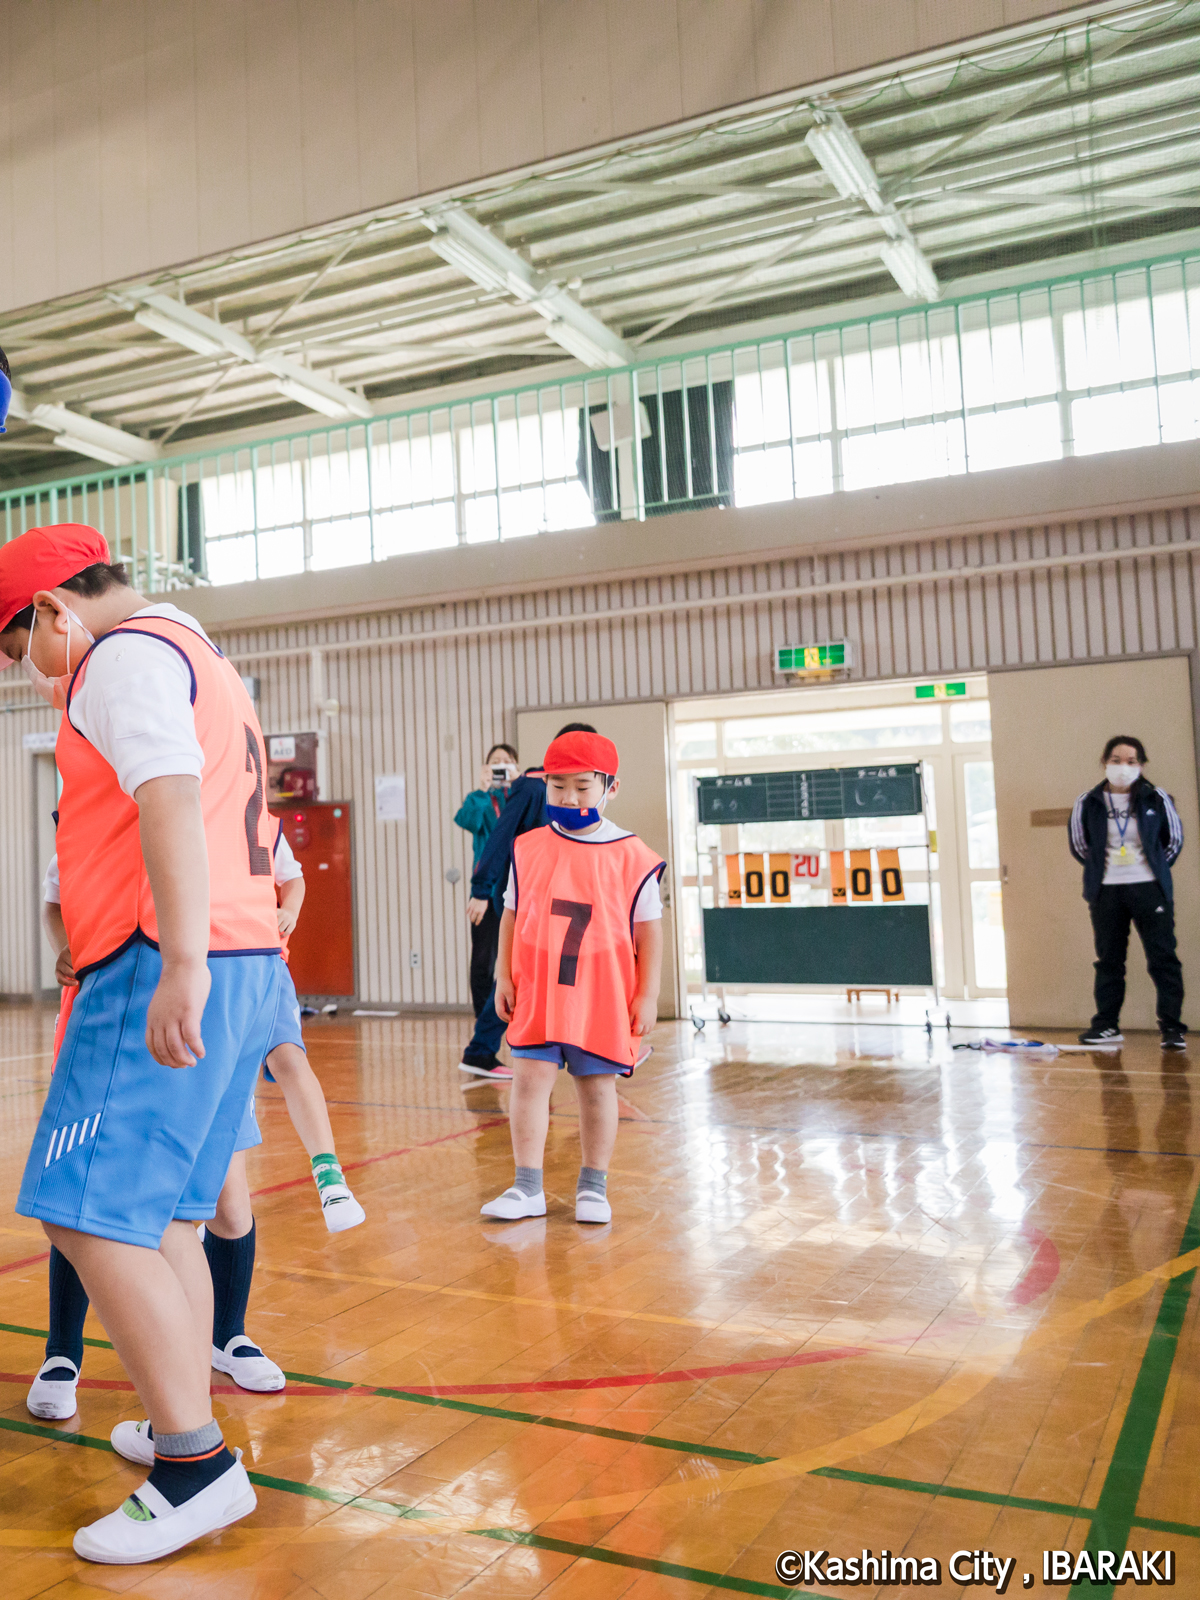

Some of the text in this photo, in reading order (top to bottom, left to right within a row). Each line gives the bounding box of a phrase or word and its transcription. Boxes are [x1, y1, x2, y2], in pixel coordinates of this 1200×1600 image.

[274, 748, 293, 756] AED
[243, 722, 272, 876] 2
[551, 897, 593, 987] 7
